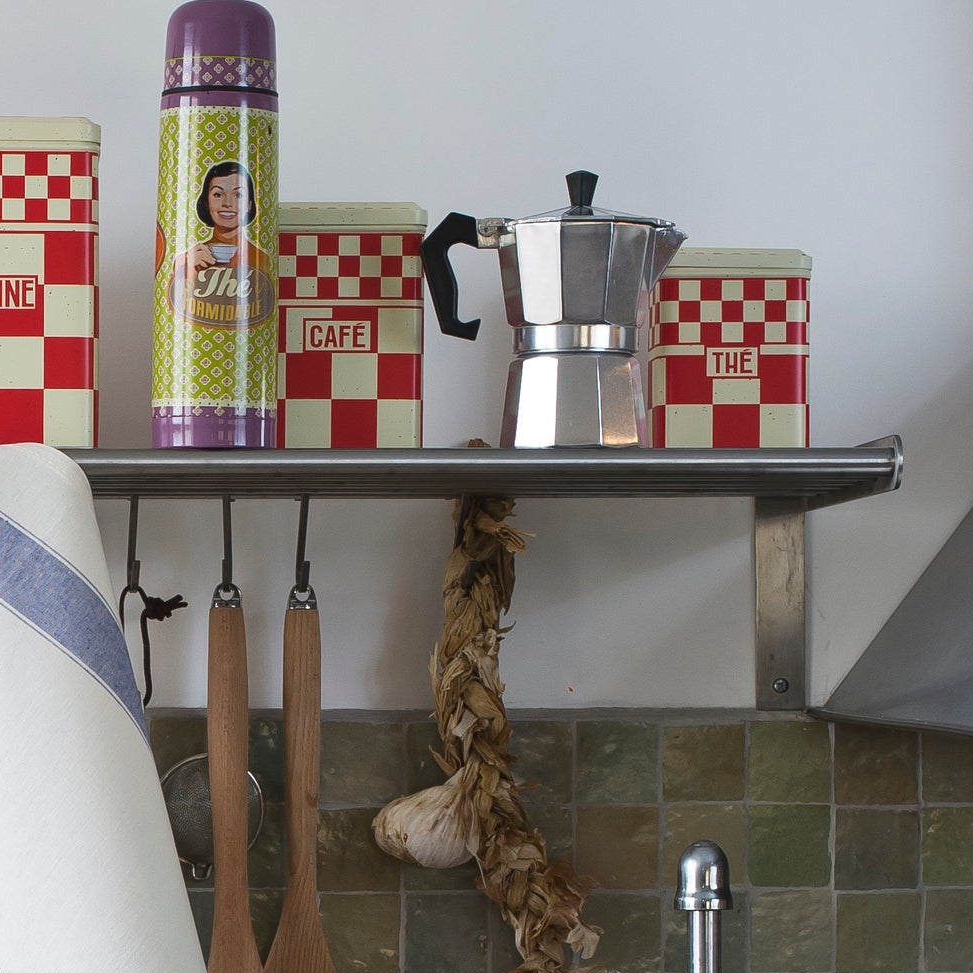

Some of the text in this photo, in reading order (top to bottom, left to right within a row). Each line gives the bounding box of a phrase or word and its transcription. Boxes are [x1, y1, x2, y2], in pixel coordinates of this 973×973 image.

[193, 266, 254, 298] Thé
[310, 321, 366, 348] CAFÉ
[711, 349, 753, 374] THÉ
